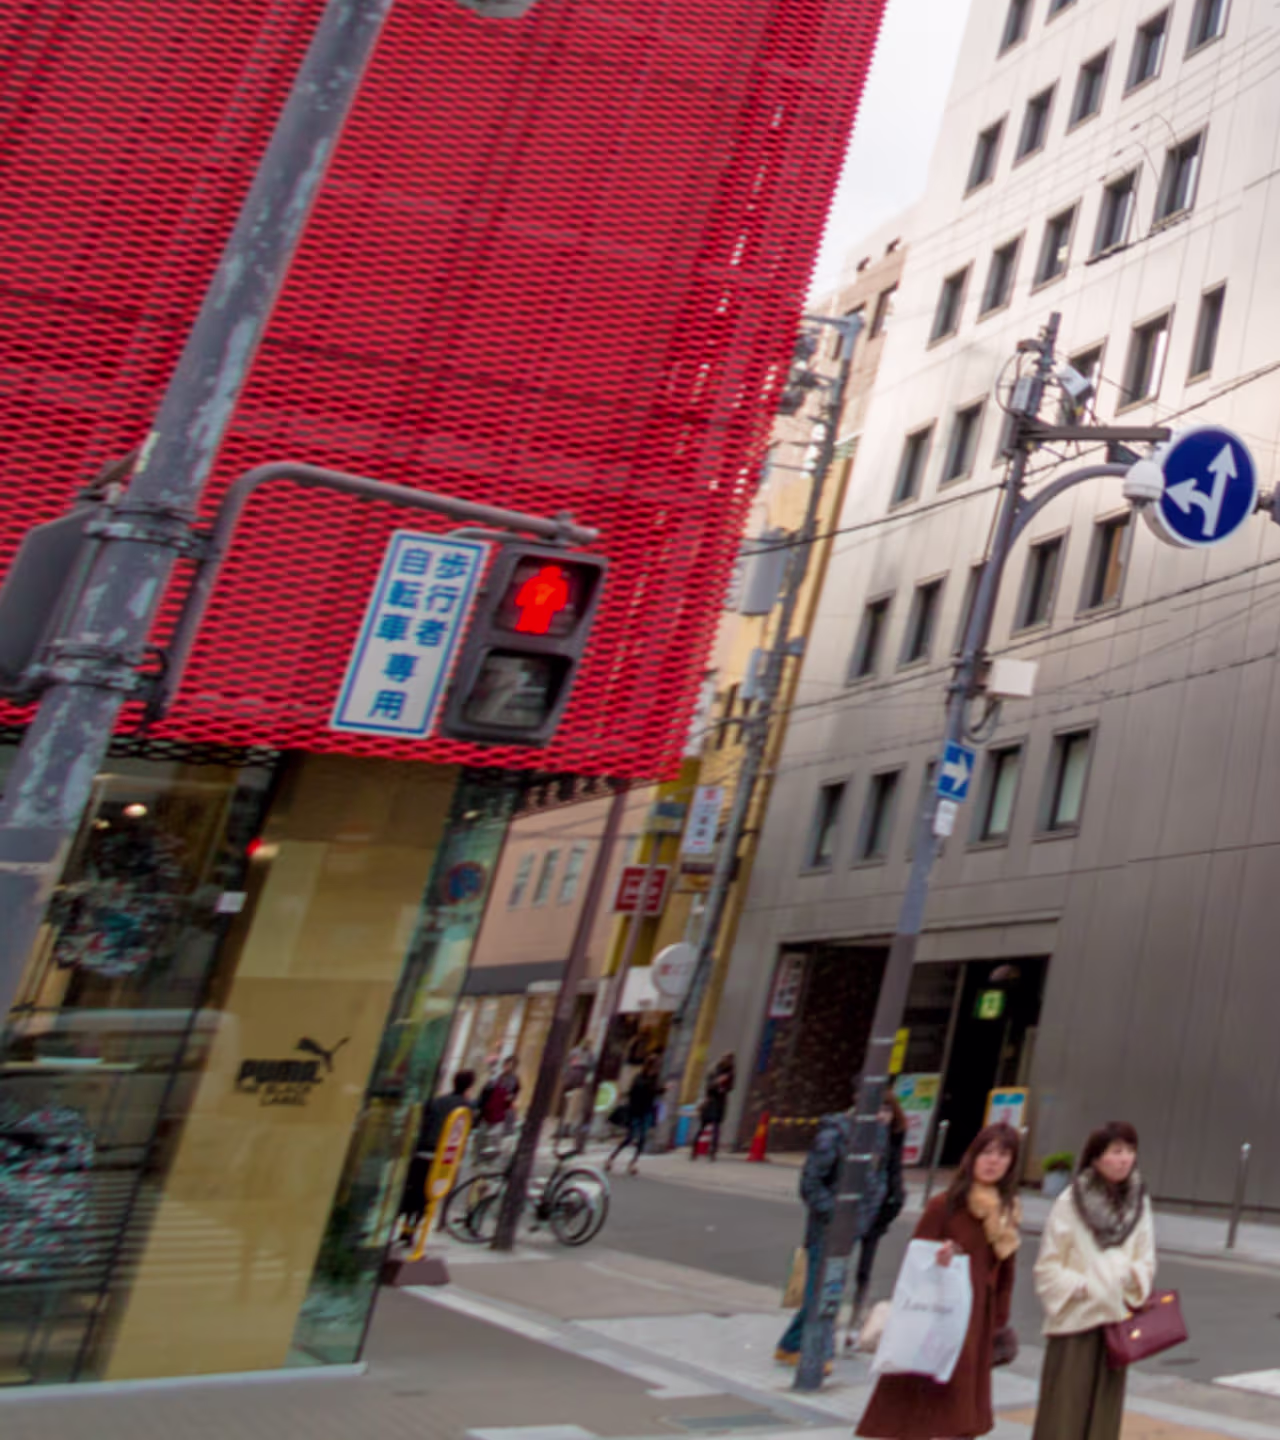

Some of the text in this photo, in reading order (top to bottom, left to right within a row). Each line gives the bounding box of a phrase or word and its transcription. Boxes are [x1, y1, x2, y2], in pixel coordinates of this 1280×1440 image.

[375, 547, 432, 642] 自転車
[415, 552, 470, 647] 歩行者
[367, 653, 420, 720] 専用
